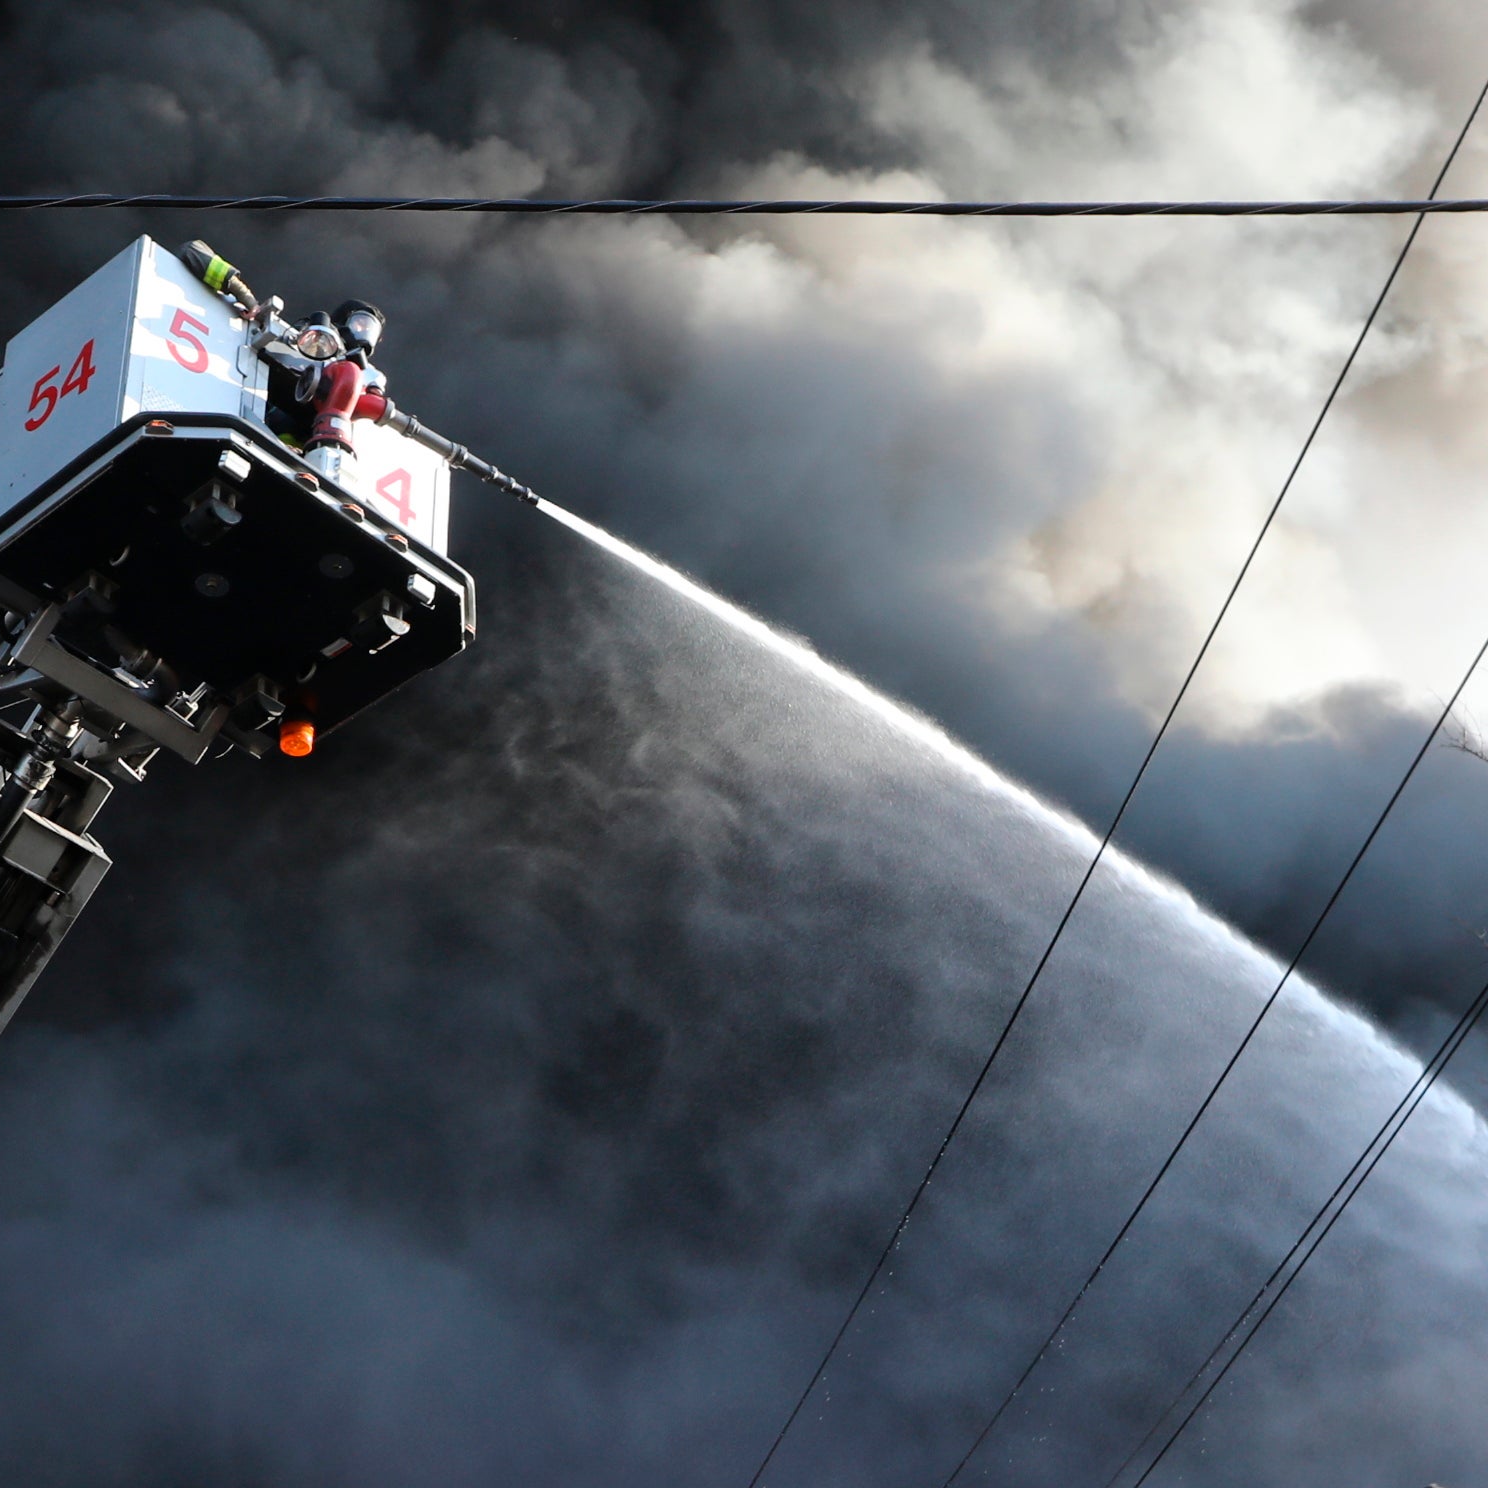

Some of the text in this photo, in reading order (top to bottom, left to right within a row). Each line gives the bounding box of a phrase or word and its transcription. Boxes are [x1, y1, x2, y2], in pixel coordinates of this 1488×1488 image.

[165, 307, 210, 374] 5
[24, 338, 97, 432] 54
[375, 467, 417, 527] 4
